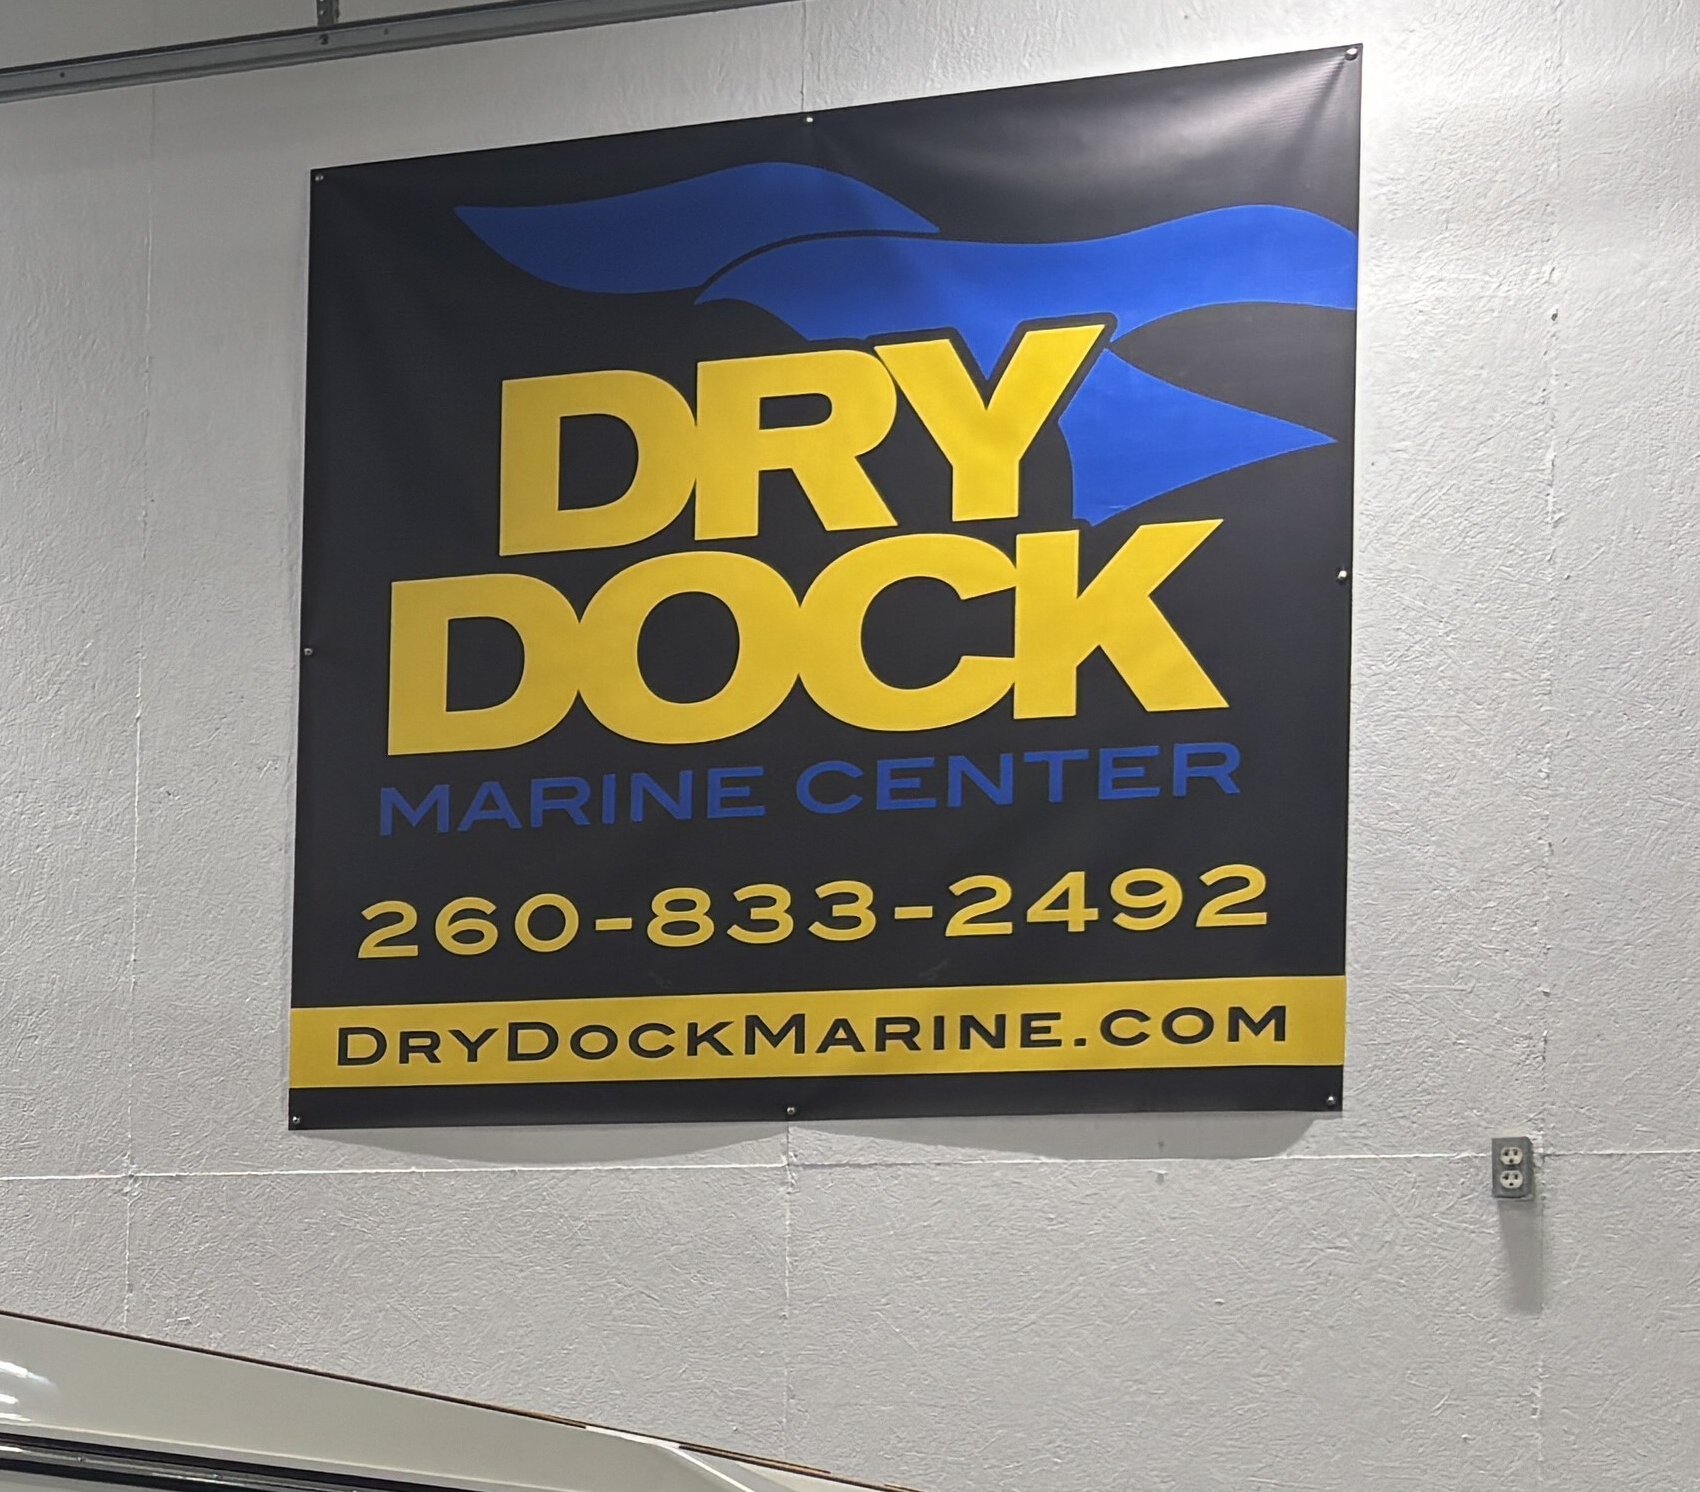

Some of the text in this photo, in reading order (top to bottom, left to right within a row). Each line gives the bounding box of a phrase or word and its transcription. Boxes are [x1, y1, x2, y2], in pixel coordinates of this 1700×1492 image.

[501, 324, 1105, 555] DRY
[389, 519, 1229, 755] DOCK
[381, 741, 1242, 836] MARINE CENTER
[359, 863, 1268, 959] 260-833-2492
